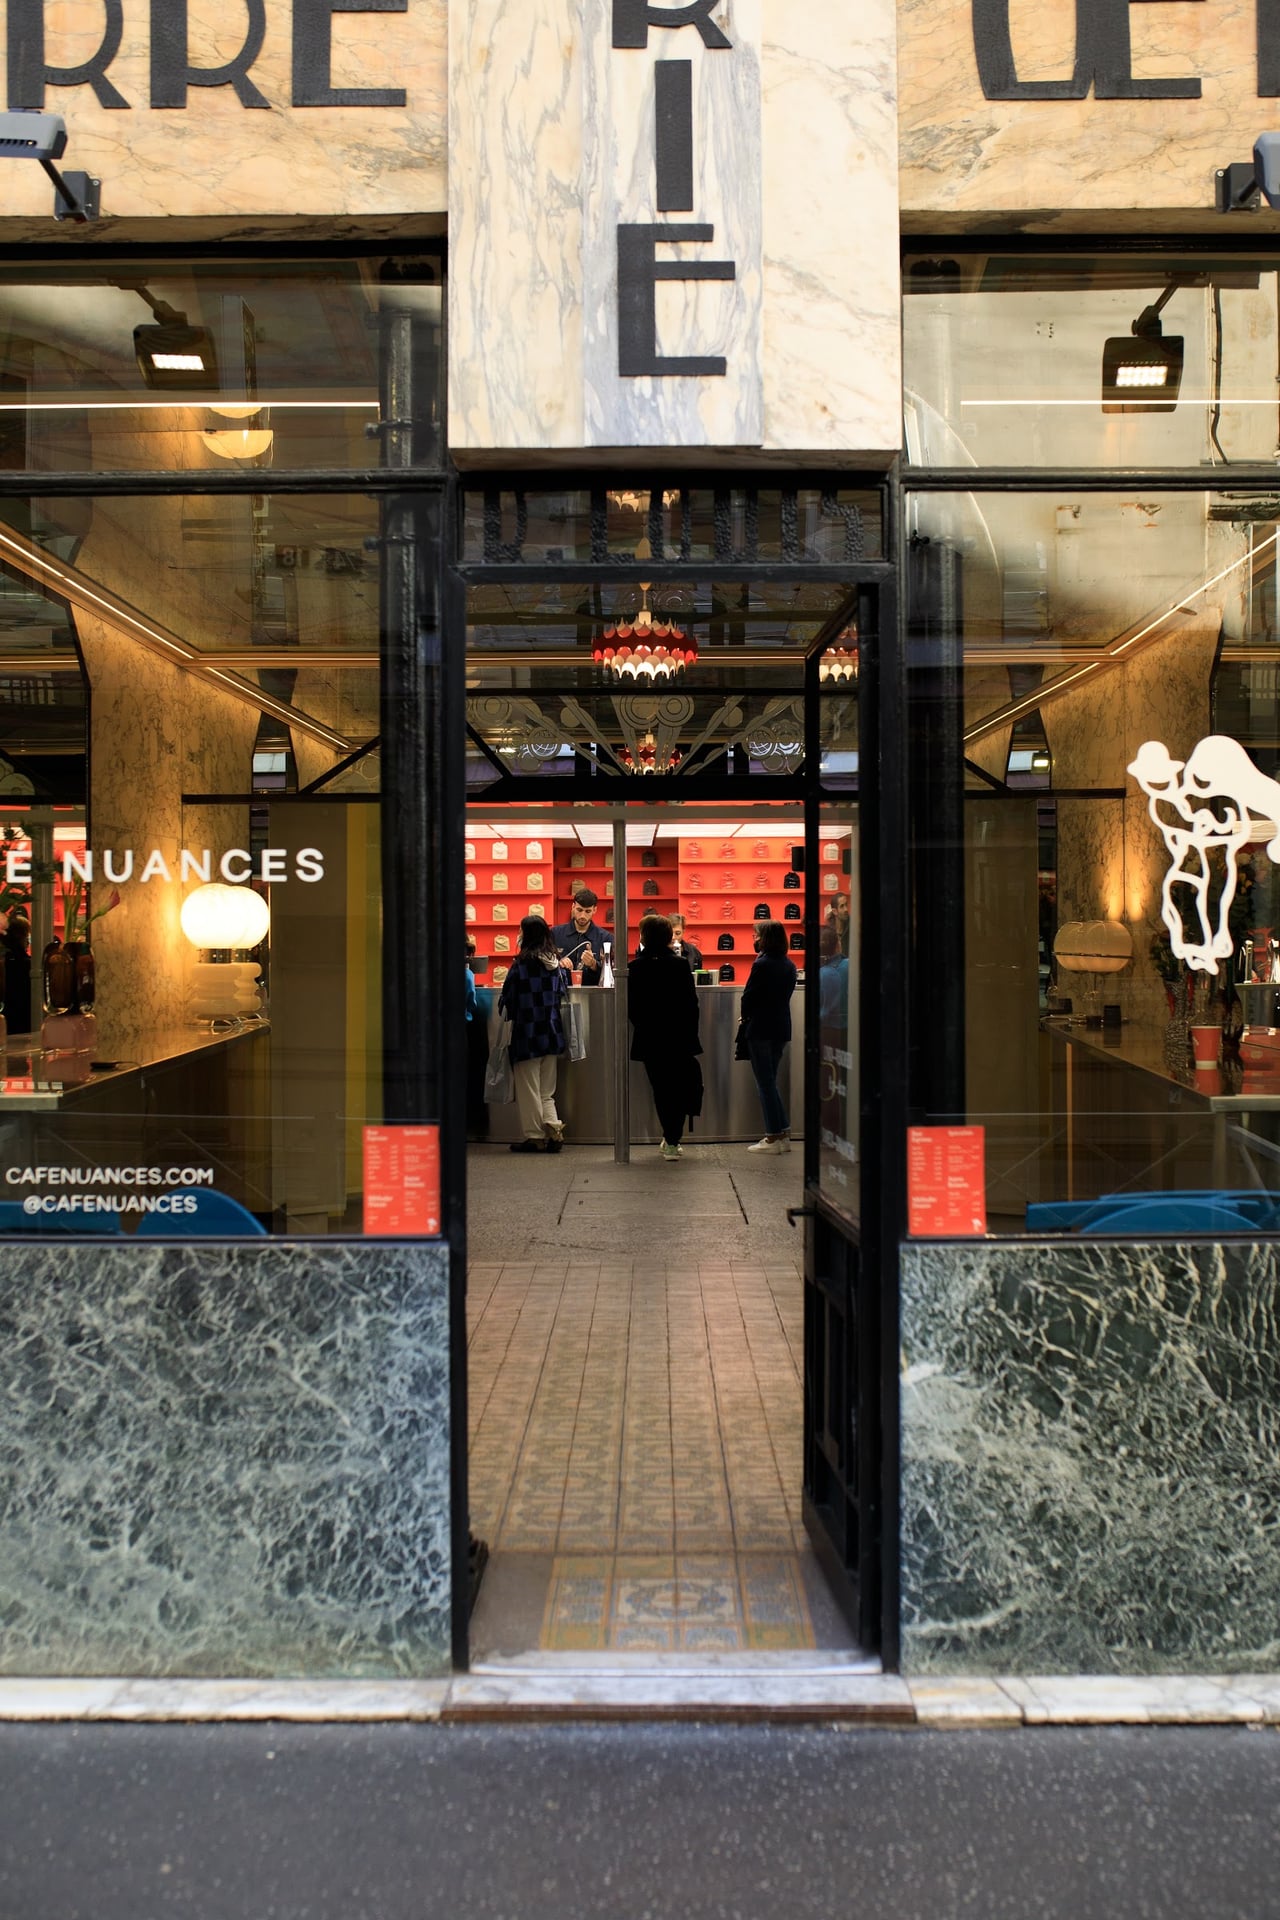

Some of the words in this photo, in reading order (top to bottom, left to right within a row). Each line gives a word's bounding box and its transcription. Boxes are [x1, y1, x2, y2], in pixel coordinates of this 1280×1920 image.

[63, 848, 325, 883] NUANCES
[5, 1166, 214, 1185] CAFENUANCES.COM
[23, 1195, 198, 1215] @CAFENUANCES
